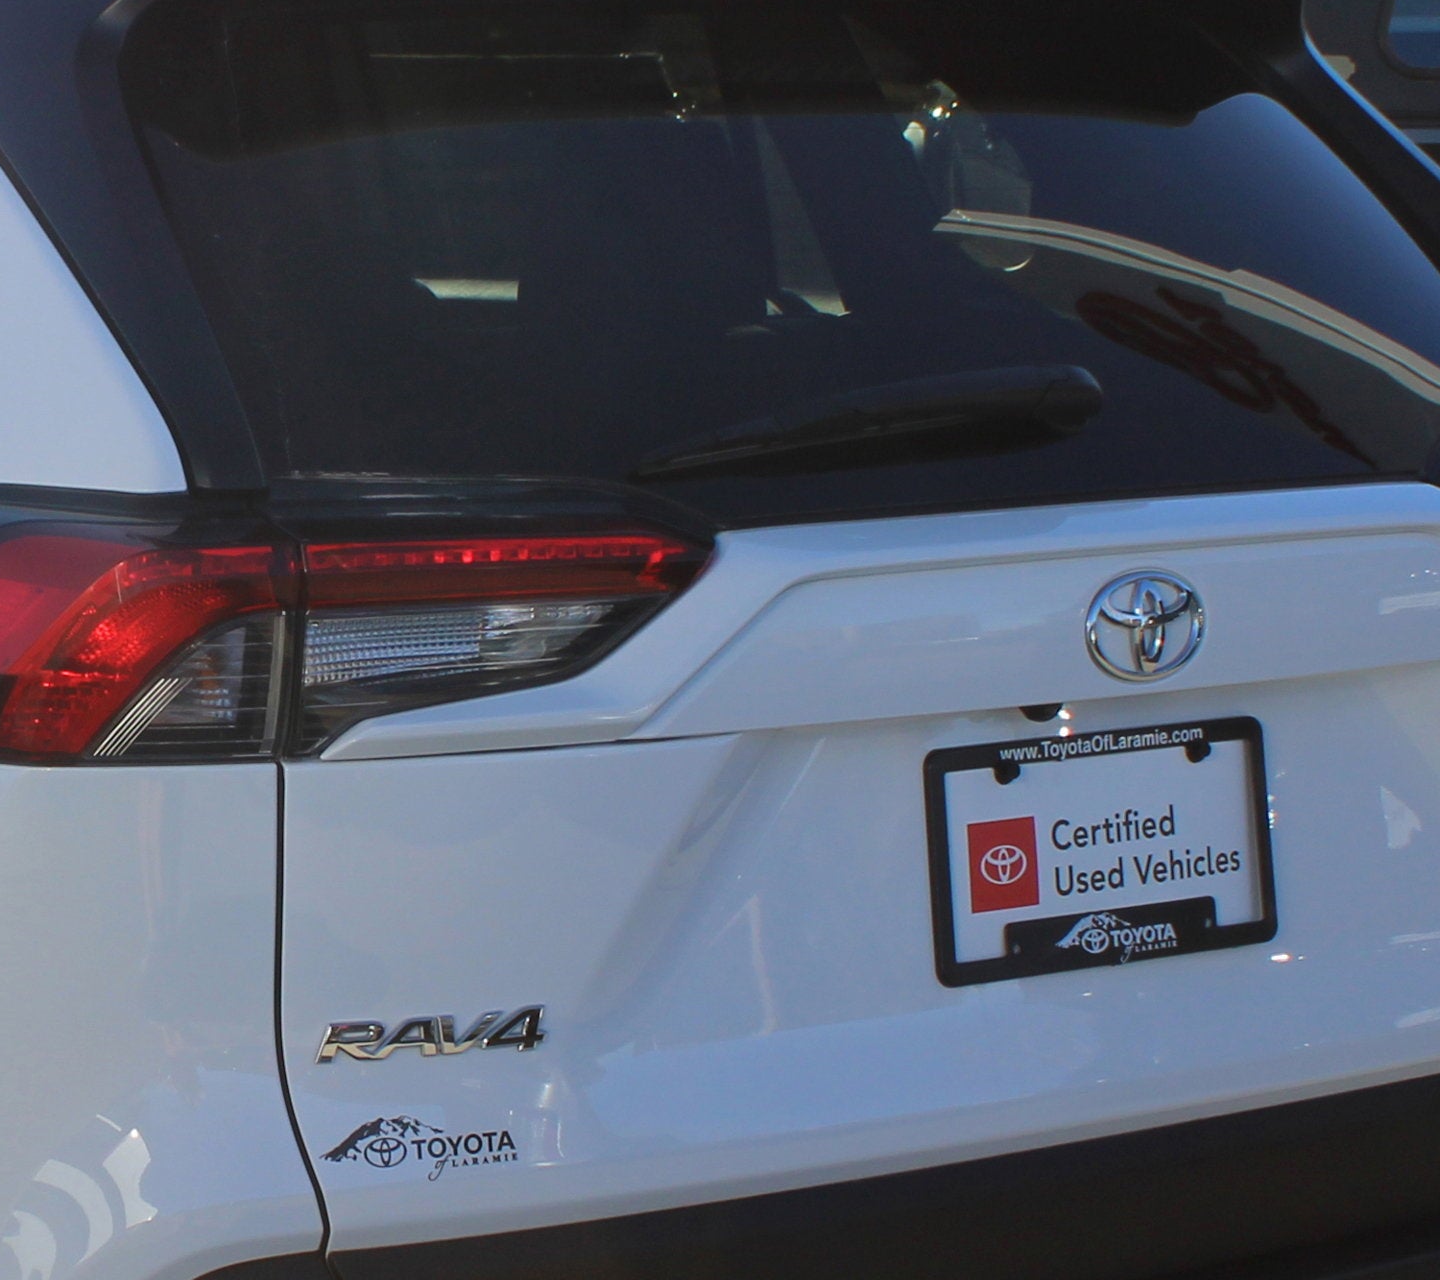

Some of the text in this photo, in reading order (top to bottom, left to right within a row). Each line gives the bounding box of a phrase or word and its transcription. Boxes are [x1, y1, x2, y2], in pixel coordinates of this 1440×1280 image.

[1000, 726, 1203, 761] www.ToyotaOfLaramie.com
[1051, 804, 1175, 851] Certified
[1055, 846, 1240, 896] Used Vehicles
[1110, 923, 1177, 947] TOYOTA
[1134, 940, 1178, 953] LARAMIE
[315, 1003, 548, 1065] RAV4
[411, 1130, 515, 1161] TOYOTA
[428, 1152, 519, 1182] of LARAMIE
